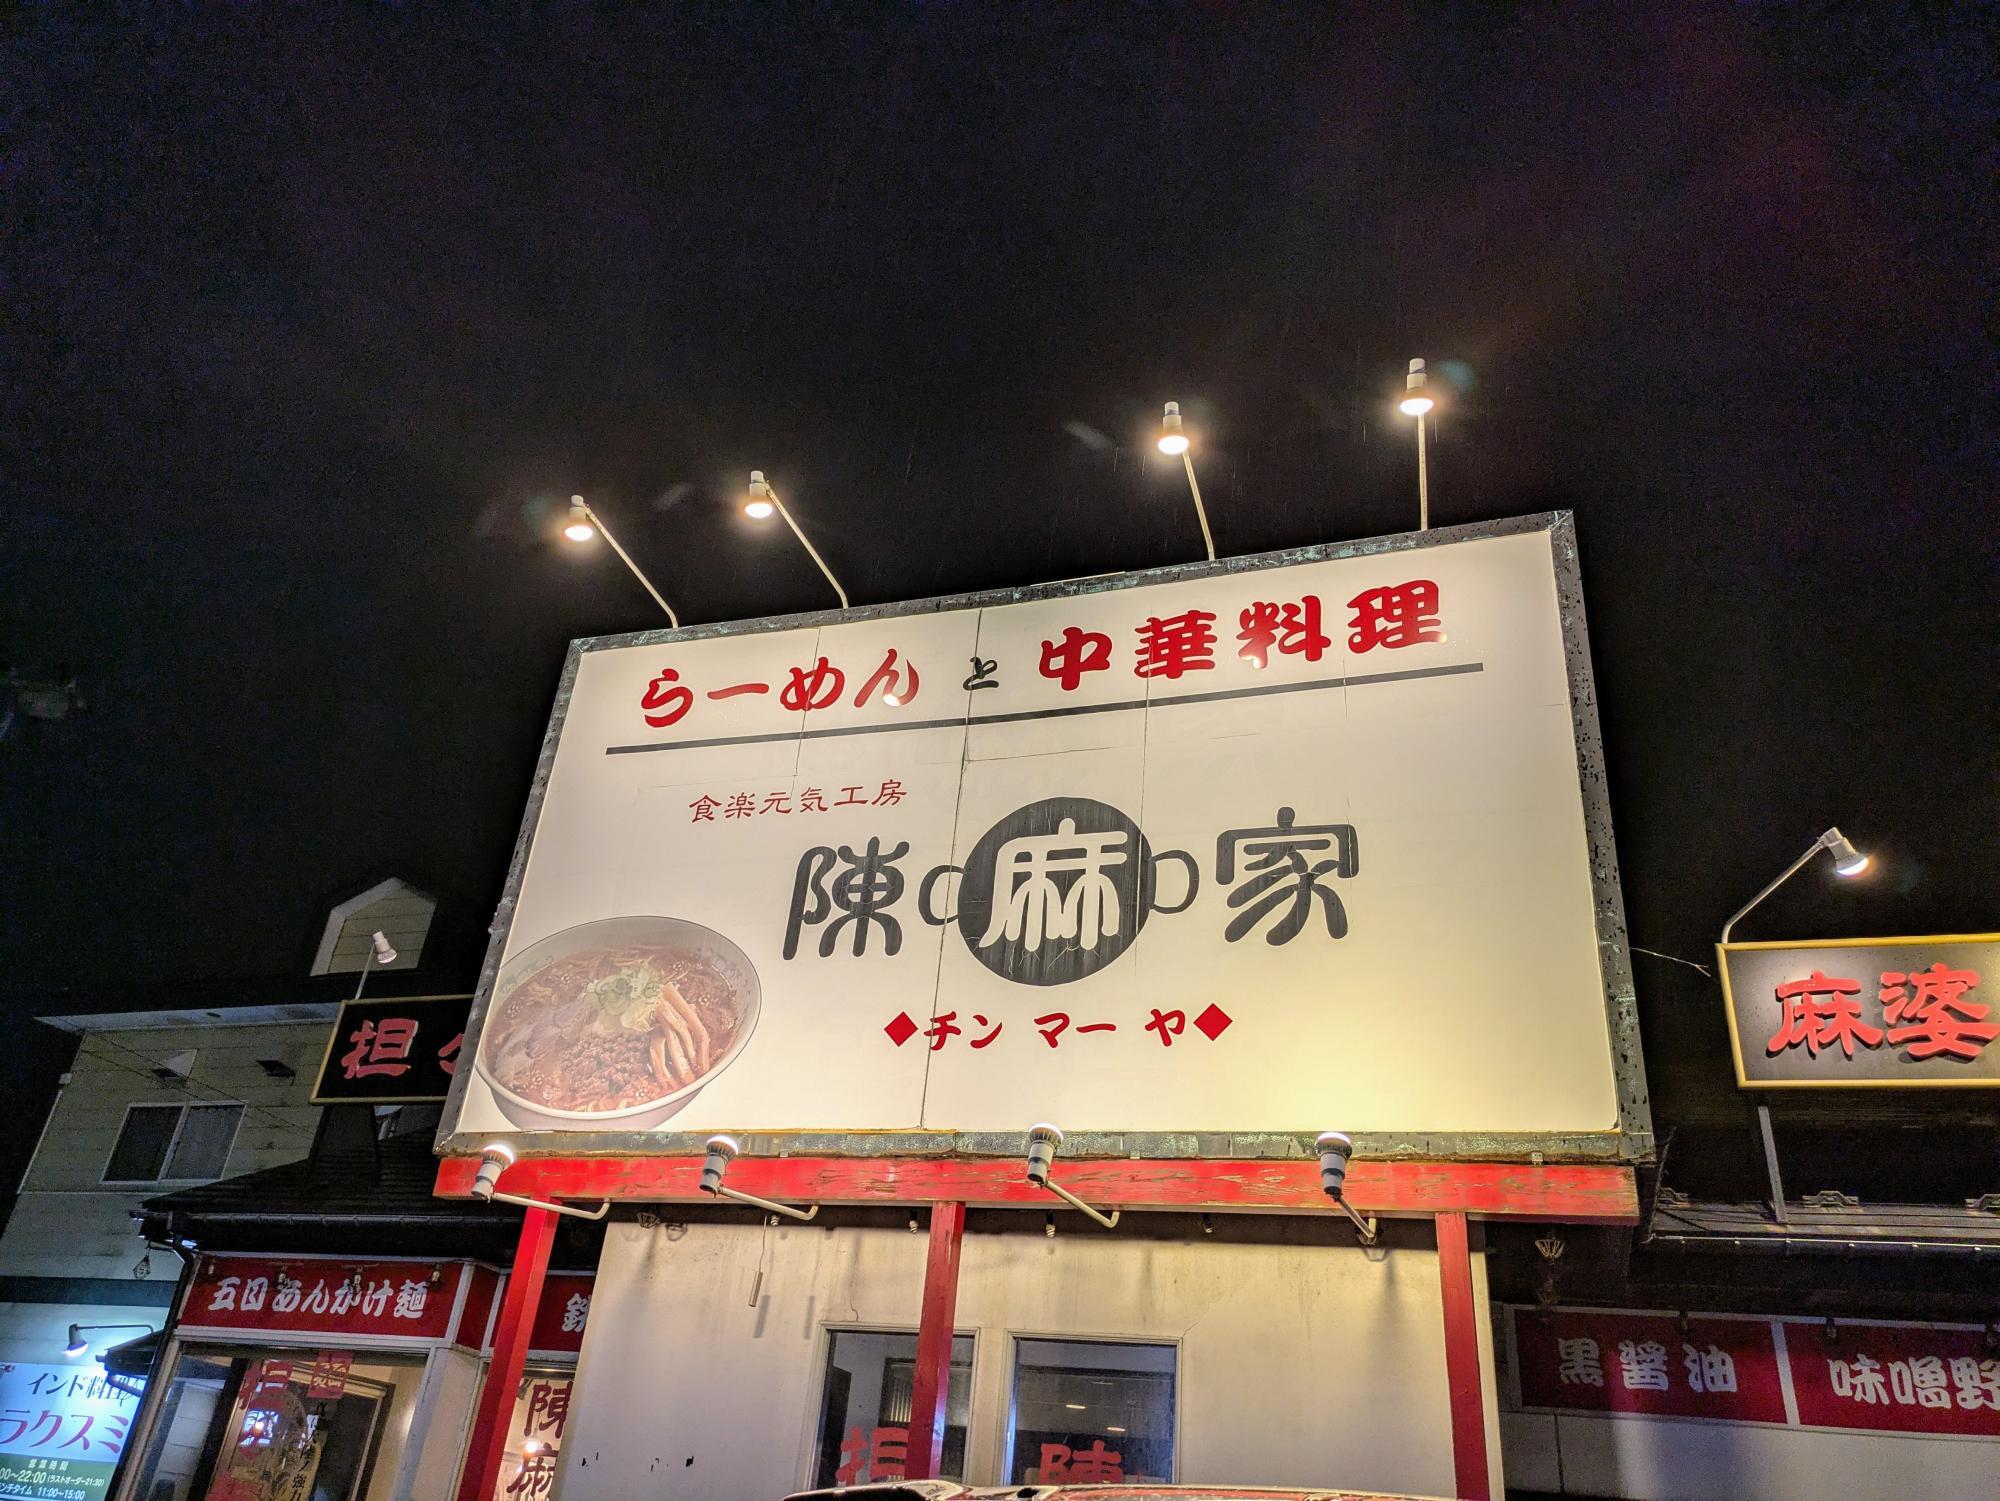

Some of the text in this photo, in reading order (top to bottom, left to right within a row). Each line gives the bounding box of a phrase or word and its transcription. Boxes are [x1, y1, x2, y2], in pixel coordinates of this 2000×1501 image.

[640, 579, 1442, 728] らーめん と 中華料理
[688, 779, 908, 823] 食楽元気工房
[1767, 962, 2000, 1057] 麻婆
